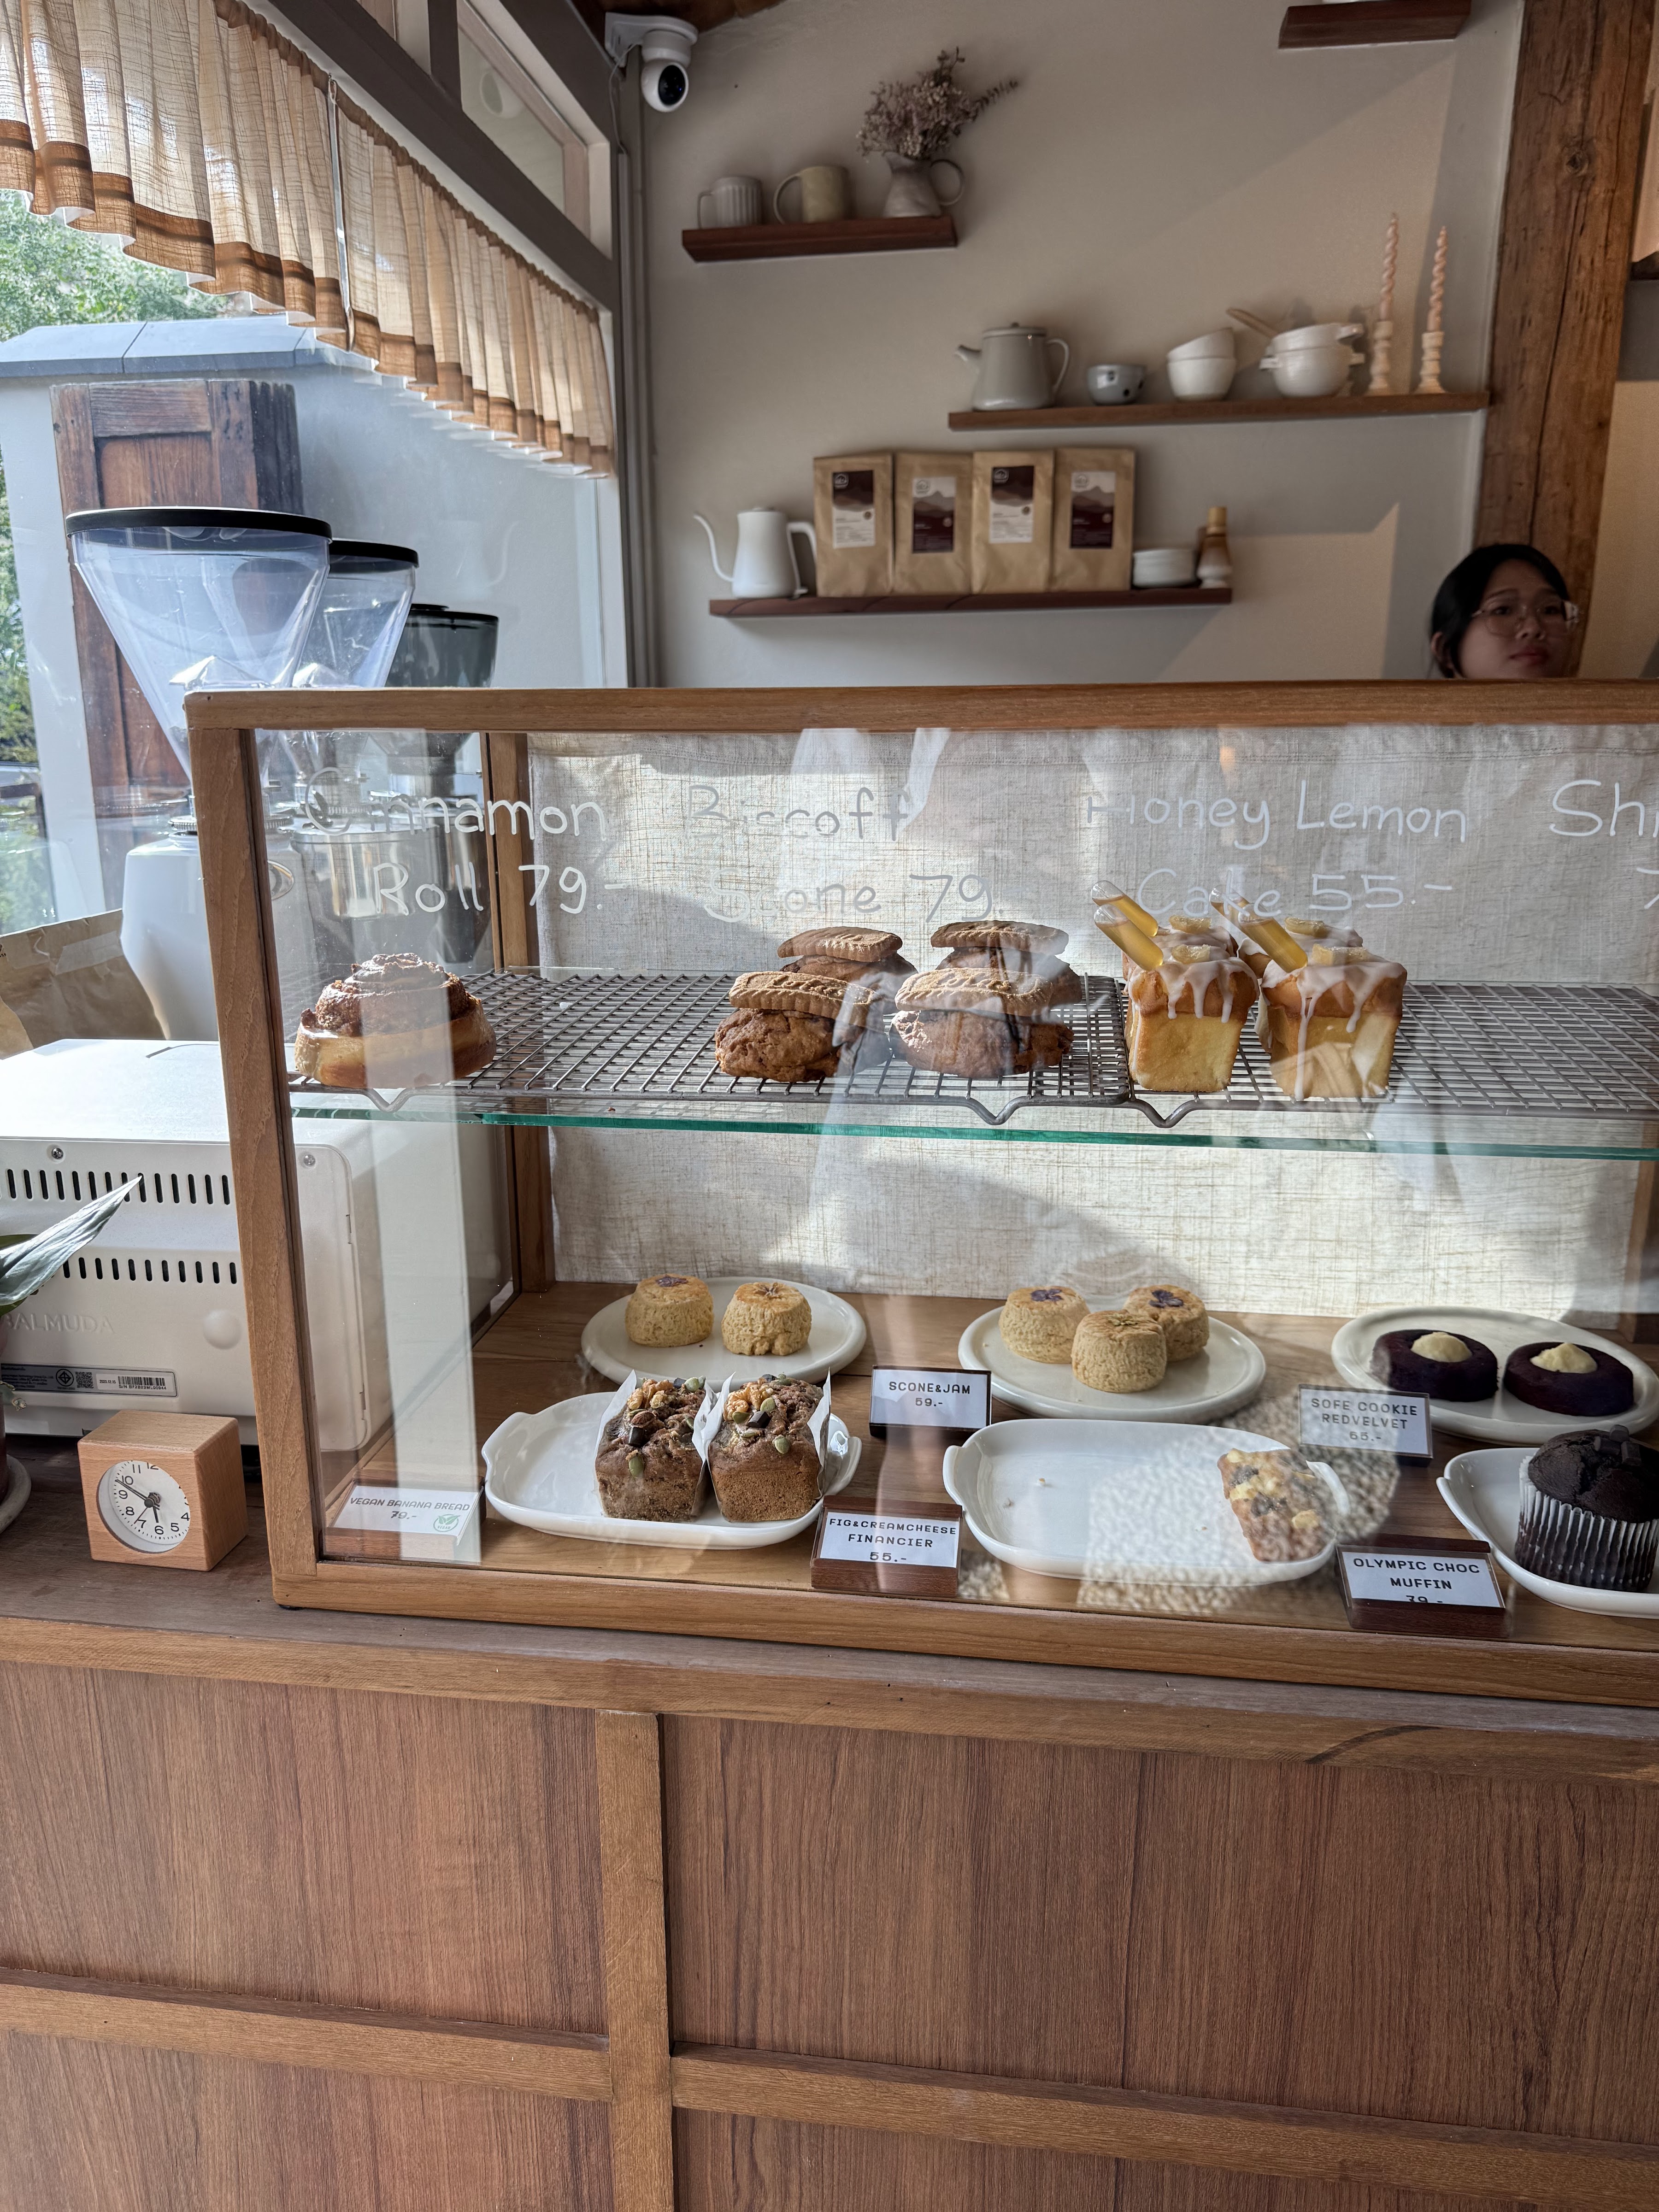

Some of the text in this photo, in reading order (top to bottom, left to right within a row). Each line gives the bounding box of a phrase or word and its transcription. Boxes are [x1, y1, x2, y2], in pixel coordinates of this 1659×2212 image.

[305, 766, 606, 841] Cinnamon
[1087, 779, 1466, 850] Honey Lemon
[374, 862, 483, 916] Roll
[1137, 867, 1453, 917] Cake 55.-
[704, 868, 881, 923] Scone
[889, 1382, 970, 1394] SCONE&JAM
[915, 1398, 943, 1406] 59.-
[1358, 1402, 1418, 1416] COOKIE
[1322, 1413, 1407, 1429] REDVELVET
[133, 1464, 141, 1474] 11
[121, 1475, 134, 1485] 10
[118, 1490, 128, 1500] 9
[350, 1498, 470, 1511] VEGAN BANANA BREAD
[125, 1506, 135, 1516] 8
[181, 1512, 190, 1521] 4
[138, 1519, 147, 1529] 7
[154, 1525, 164, 1535] 6
[171, 1523, 180, 1532] 5
[830, 1518, 956, 1535] FIG&CREAMCHEESE
[848, 1534, 933, 1547] FINANCIER
[870, 1552, 907, 1562] 55.-
[1353, 1558, 1480, 1573] OLYMPIC CHOC
[1390, 1577, 1452, 1589] MUFFIN
